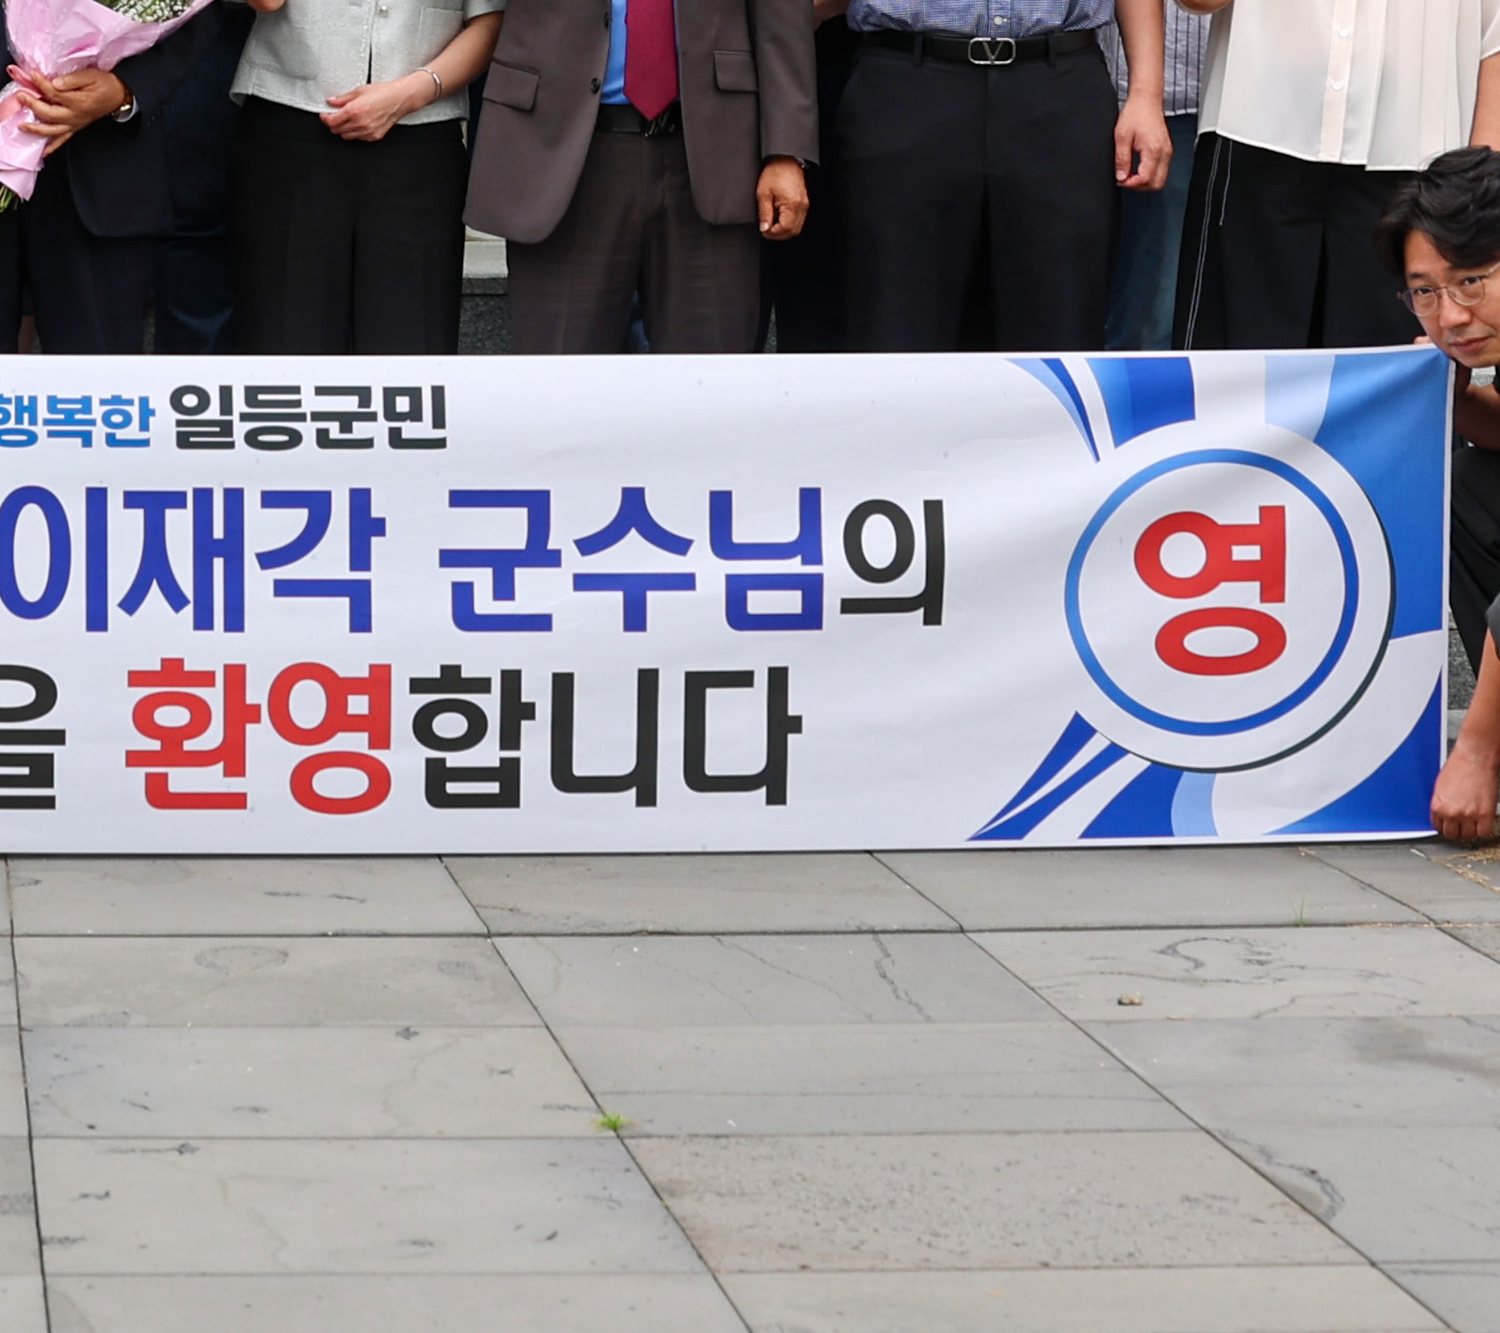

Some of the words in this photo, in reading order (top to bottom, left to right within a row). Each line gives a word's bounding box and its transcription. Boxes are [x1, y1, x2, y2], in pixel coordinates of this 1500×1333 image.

[169, 385, 448, 451] 일등군민
[438, 487, 946, 632] 군수님의
[1133, 505, 1287, 677] 영
[125, 657, 803, 815] 환영합니다
